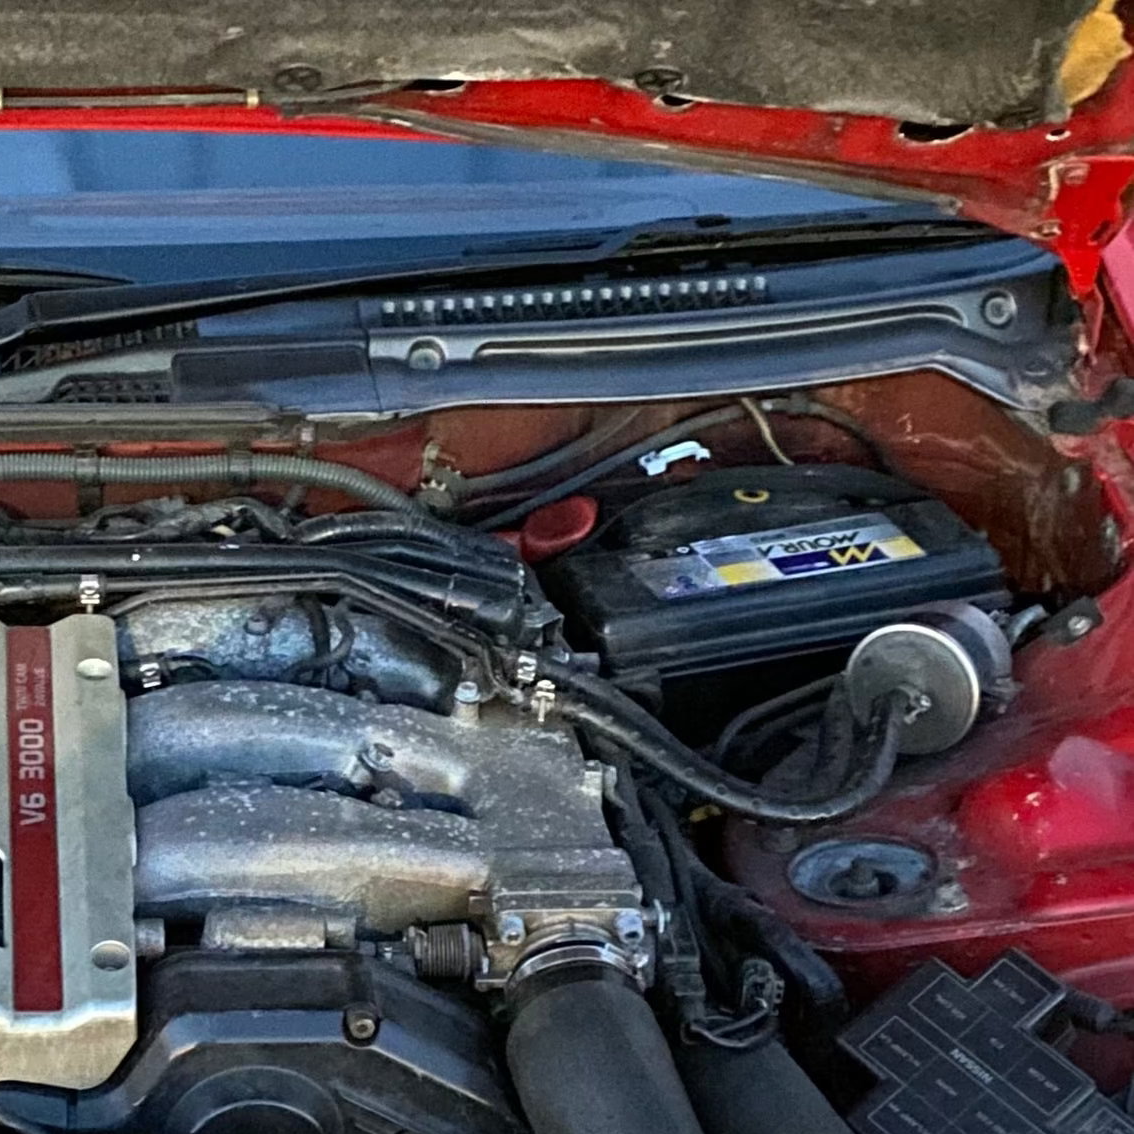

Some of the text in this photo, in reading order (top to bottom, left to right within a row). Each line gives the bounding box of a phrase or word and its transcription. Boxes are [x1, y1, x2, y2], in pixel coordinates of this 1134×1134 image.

[757, 530, 860, 558] MOURA
[18, 717, 47, 828] V6 3000
[949, 1048, 994, 1084] NISSAN
